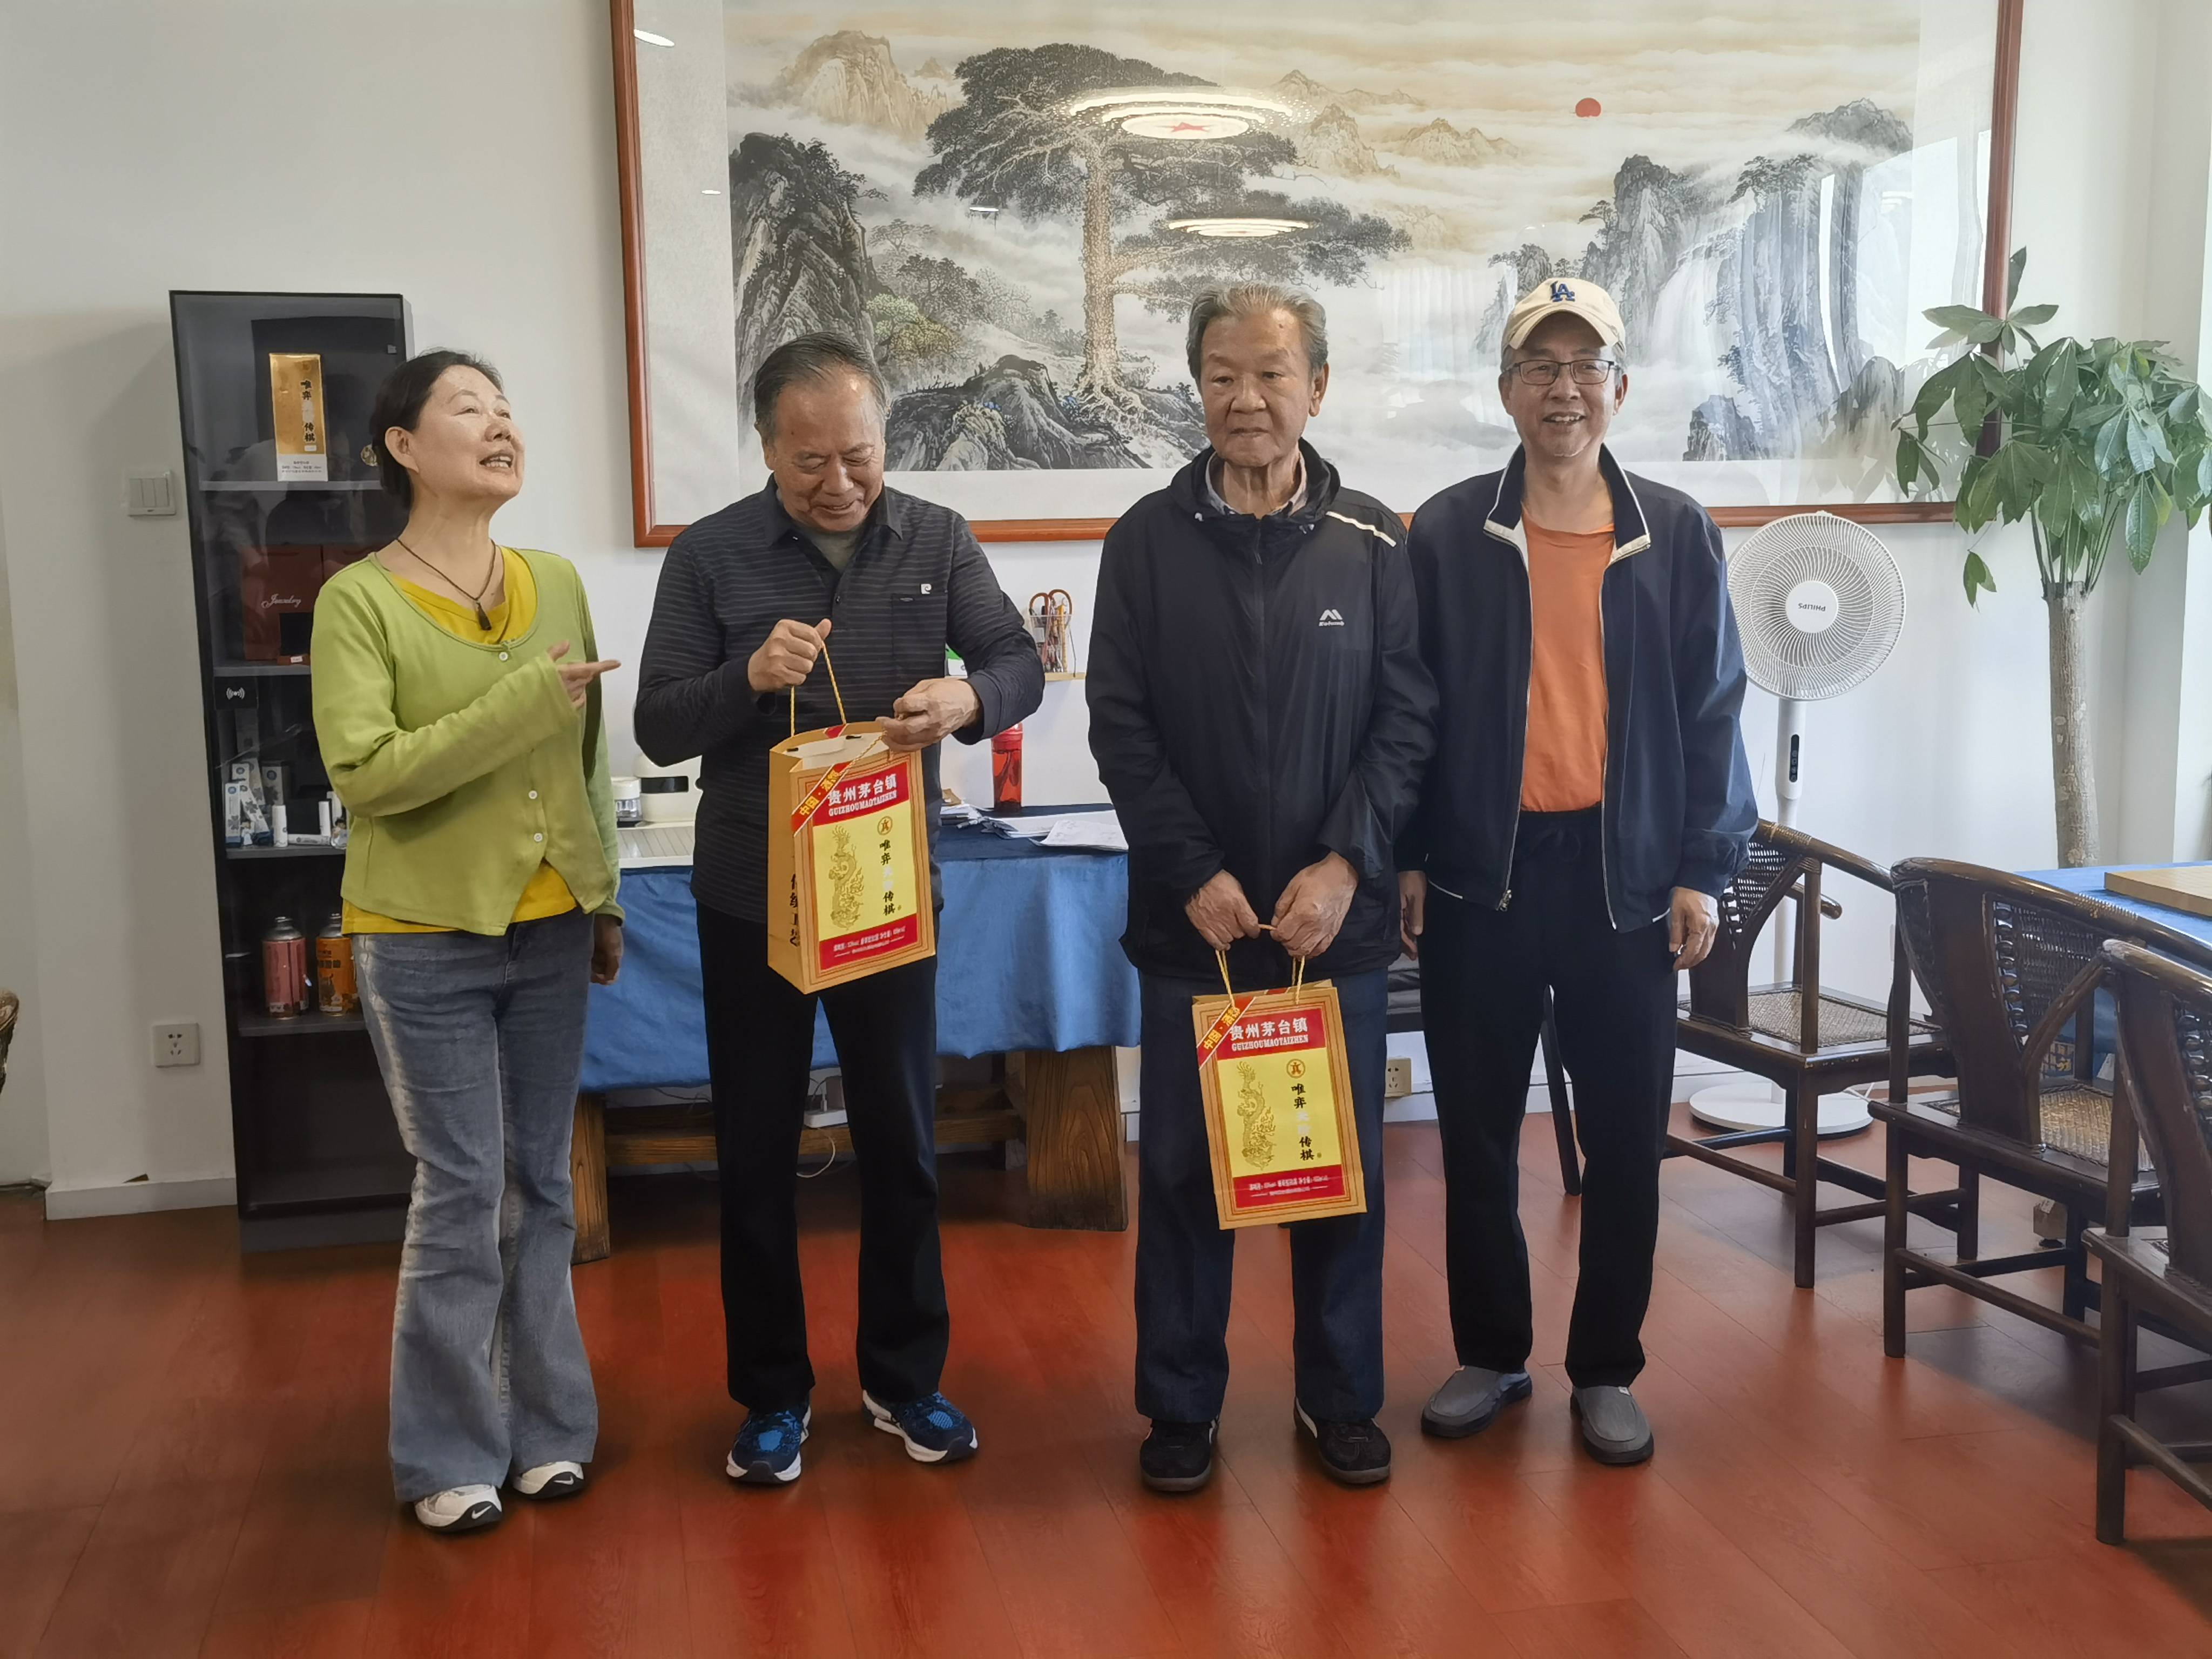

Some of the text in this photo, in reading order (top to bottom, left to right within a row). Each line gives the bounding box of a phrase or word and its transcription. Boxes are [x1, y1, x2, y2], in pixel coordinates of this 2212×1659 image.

[1550, 281, 1575, 302] LA
[1798, 603, 1826, 611] PHILIPS
[828, 774, 897, 806] 贵州茅台镇
[1230, 1017, 1308, 1041] 贵州茅台镇
[1232, 1034, 1309, 1051] GUIZHOUMAOTAIZHEN
